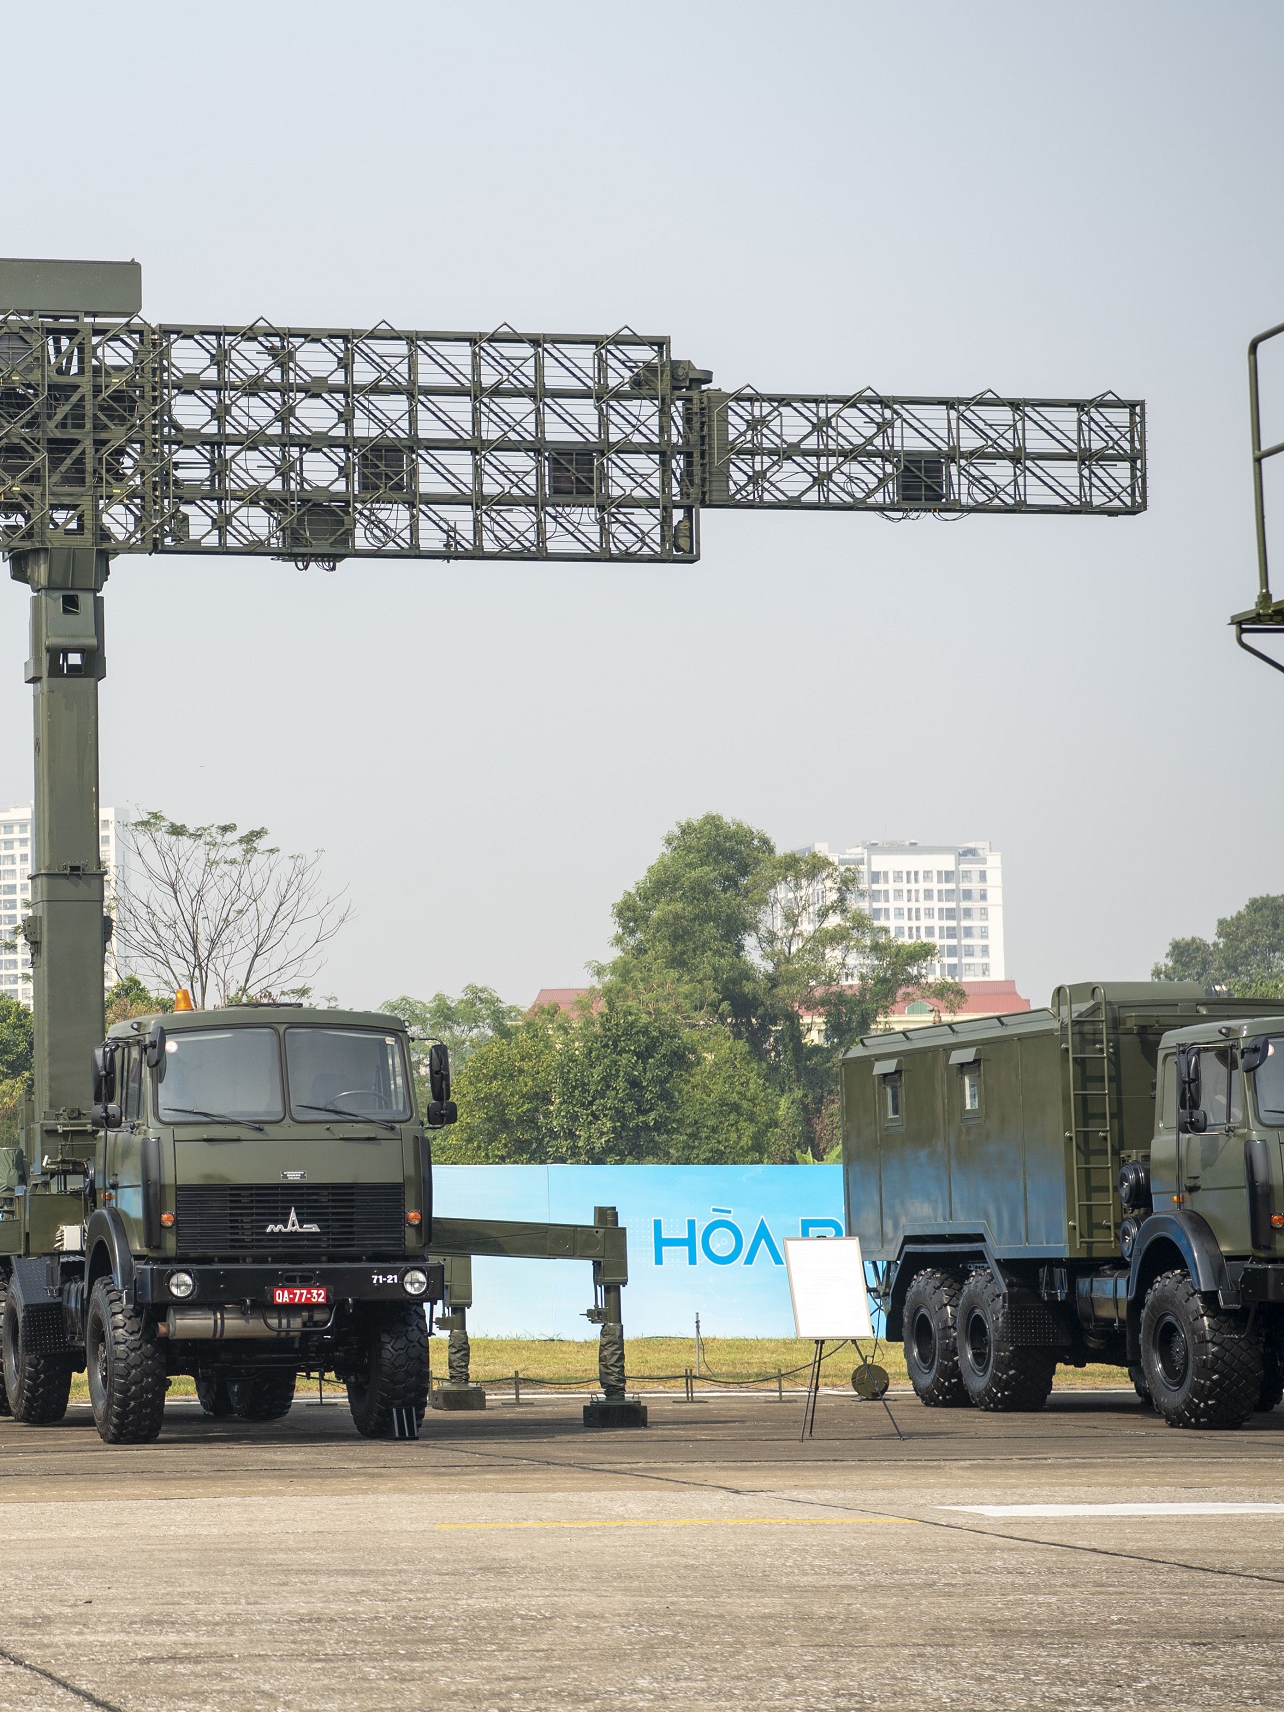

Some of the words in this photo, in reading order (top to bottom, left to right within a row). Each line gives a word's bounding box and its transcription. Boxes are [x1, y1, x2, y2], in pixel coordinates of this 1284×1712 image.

[652, 1206, 786, 1267] HÒA
[372, 1275, 398, 1284] 71-21
[276, 1290, 325, 1303] QA-77-32
